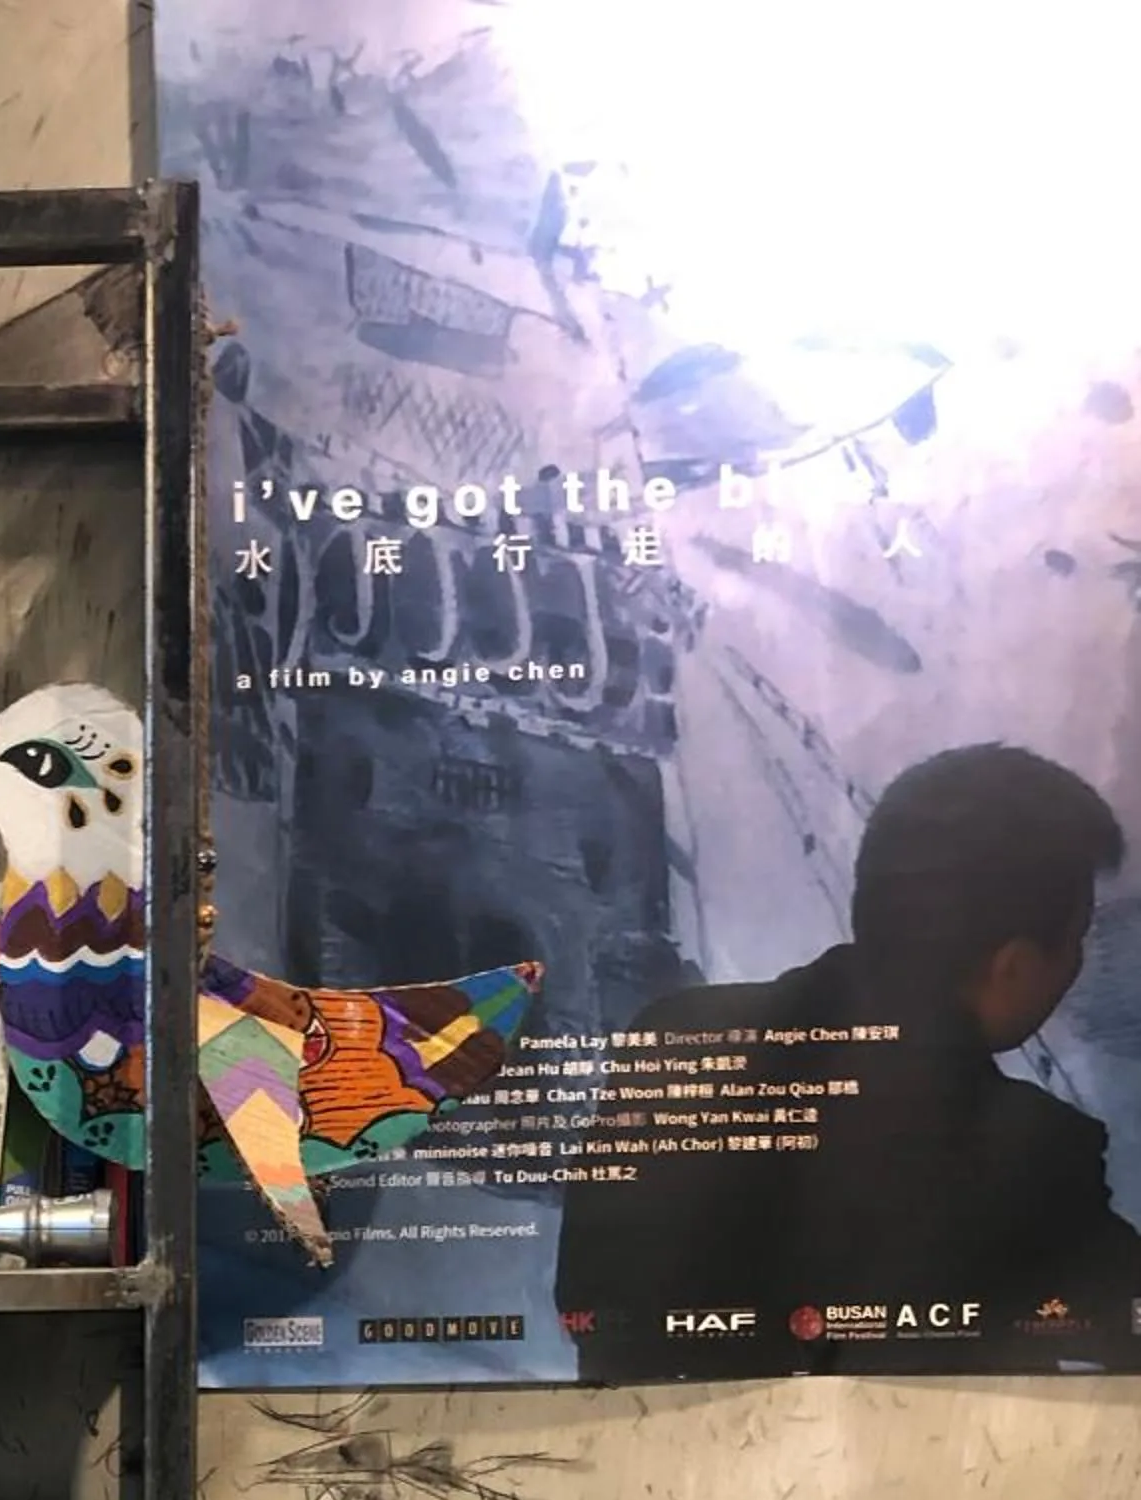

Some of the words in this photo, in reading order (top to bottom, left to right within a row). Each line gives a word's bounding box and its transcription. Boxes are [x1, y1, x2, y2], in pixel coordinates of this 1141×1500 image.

[234, 480, 363, 522] i've
[406, 474, 522, 528] got
[563, 467, 675, 512] the
[236, 675, 252, 690] a
[270, 668, 331, 687] film
[349, 667, 384, 687] by
[402, 663, 491, 686] angie
[508, 661, 585, 680] chen
[520, 1035, 577, 1050] Pamela
[580, 1036, 607, 1051] Lay
[664, 1031, 723, 1046] Director
[764, 1029, 806, 1046] Angie
[810, 1028, 849, 1042] Chen
[538, 1063, 559, 1076] Hu
[600, 1060, 630, 1074] Chu
[634, 1060, 660, 1073] Hoi
[663, 1058, 697, 1074] Ying
[547, 1088, 587, 1102] Chan
[590, 1087, 616, 1101] Tze
[620, 1086, 663, 1100] Woon
[720, 1084, 754, 1097] Alan
[759, 1083, 785, 1096] Zou
[789, 1082, 824, 1098] Qiao
[654, 1113, 697, 1128] Wong
[700, 1111, 729, 1124] Yan
[732, 1110, 769, 1123] Kwai
[560, 1143, 583, 1156] Lai
[586, 1142, 611, 1155] Kin
[615, 1141, 648, 1154] Wah
[379, 1171, 422, 1188] Editor
[494, 1170, 513, 1184] Tu
[400, 1226, 419, 1239] All
[421, 1225, 467, 1242] Rights
[469, 1222, 540, 1238] Reserved.
[826, 1305, 887, 1320] BUSAN
[665, 1313, 756, 1332] HAF
